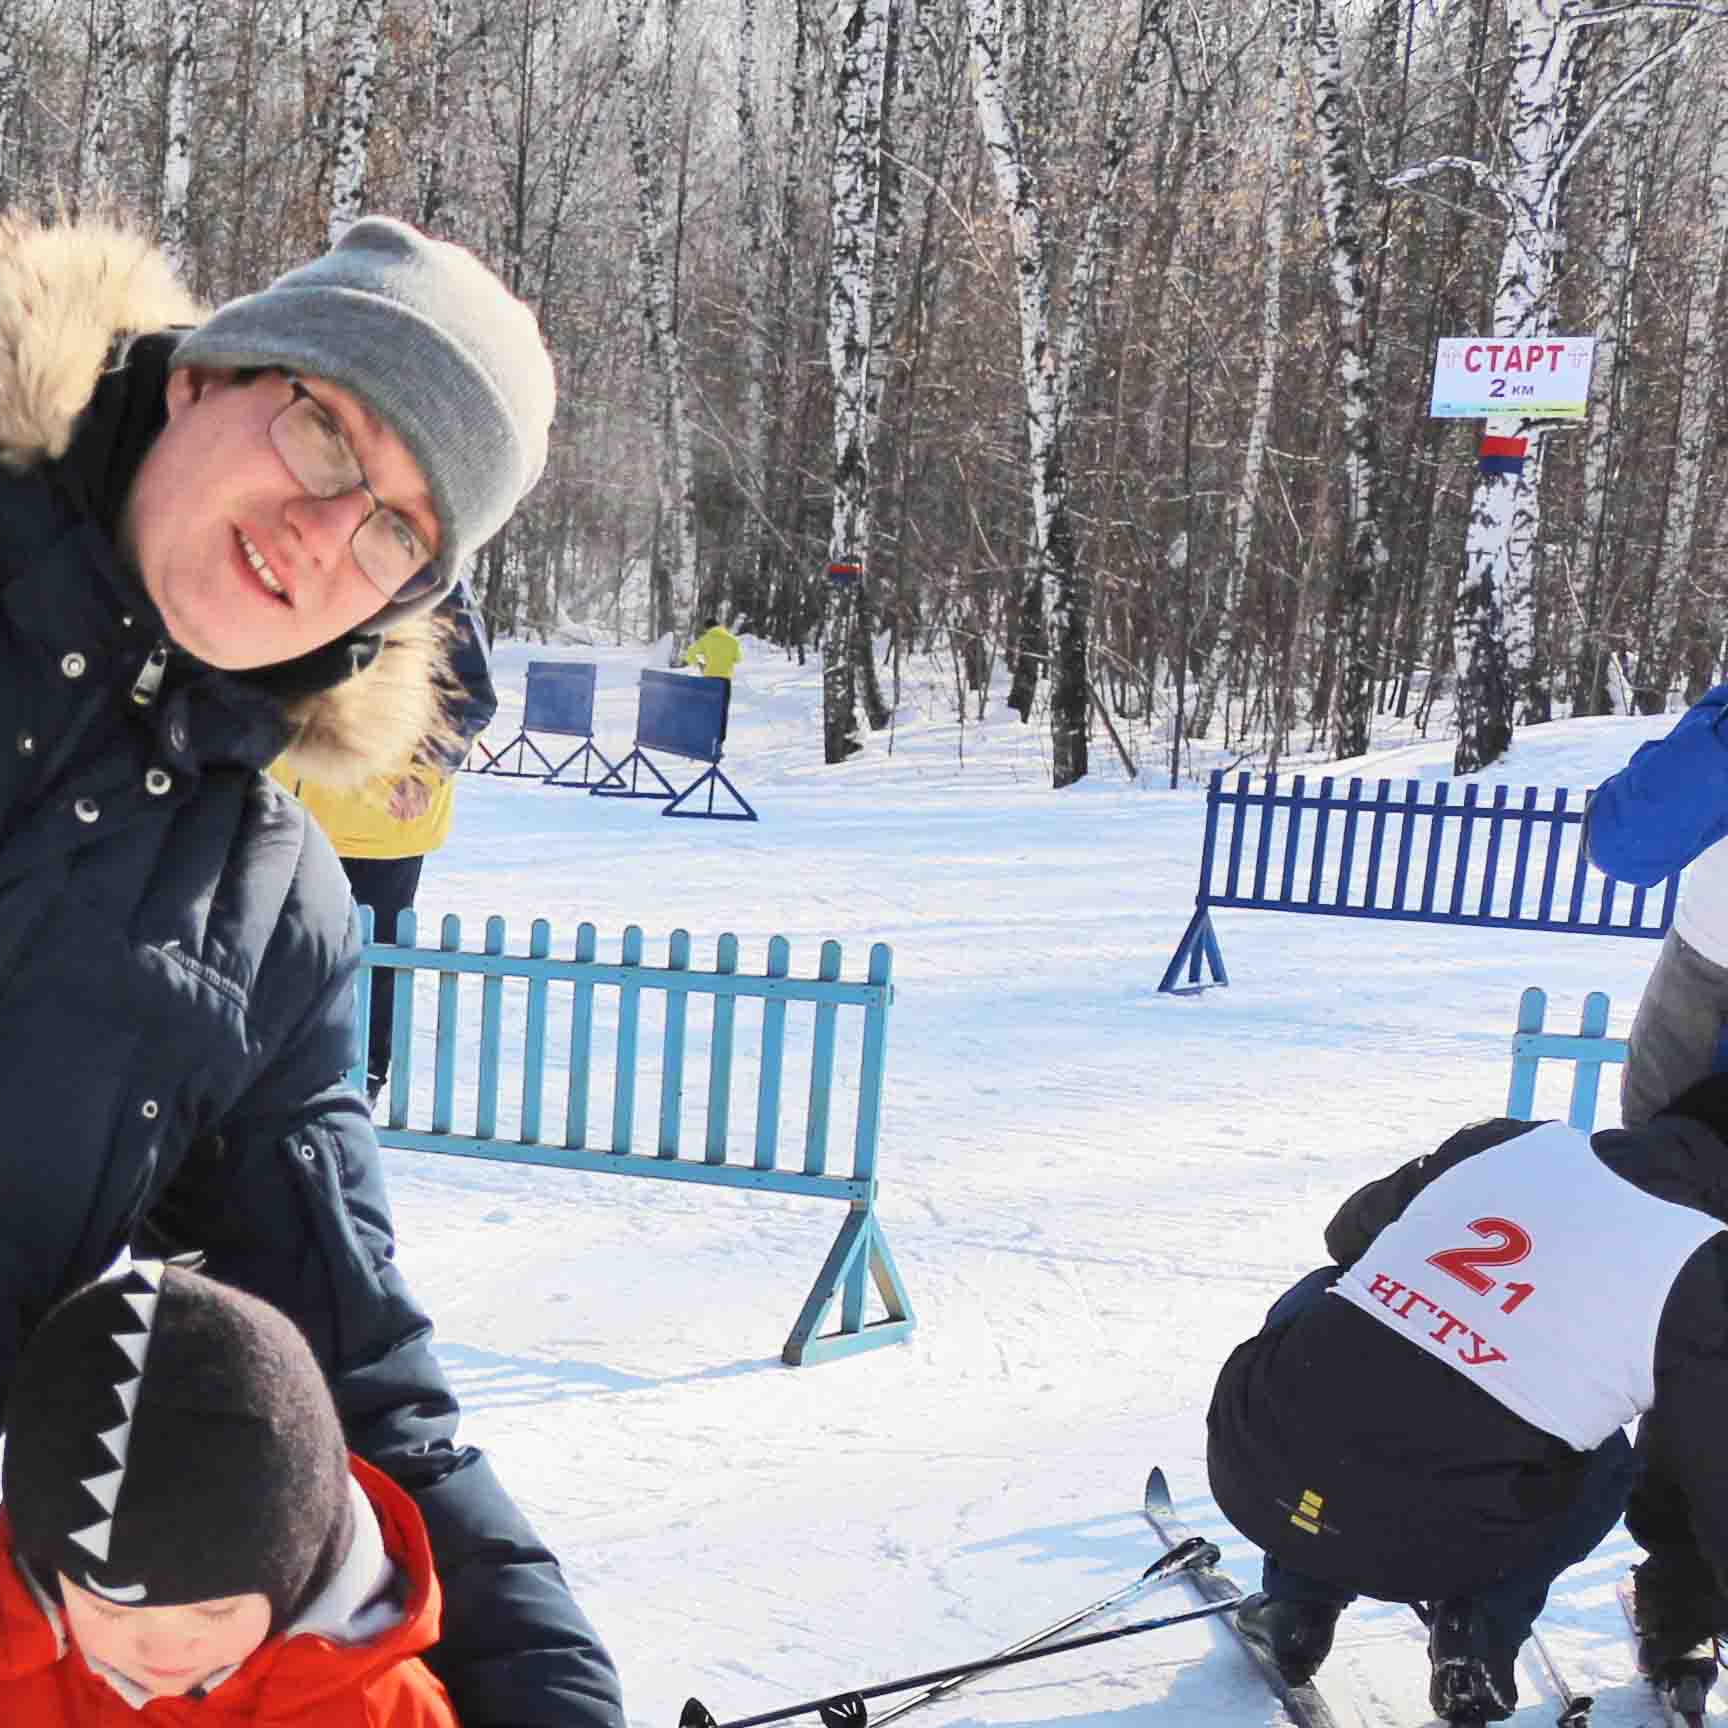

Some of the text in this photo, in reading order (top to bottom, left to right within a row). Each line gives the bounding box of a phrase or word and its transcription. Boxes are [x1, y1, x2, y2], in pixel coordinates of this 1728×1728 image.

[1465, 345, 1565, 372] СТАРТ
[1488, 378, 1506, 398] 2
[1368, 1273, 1508, 1365] НГТУ
